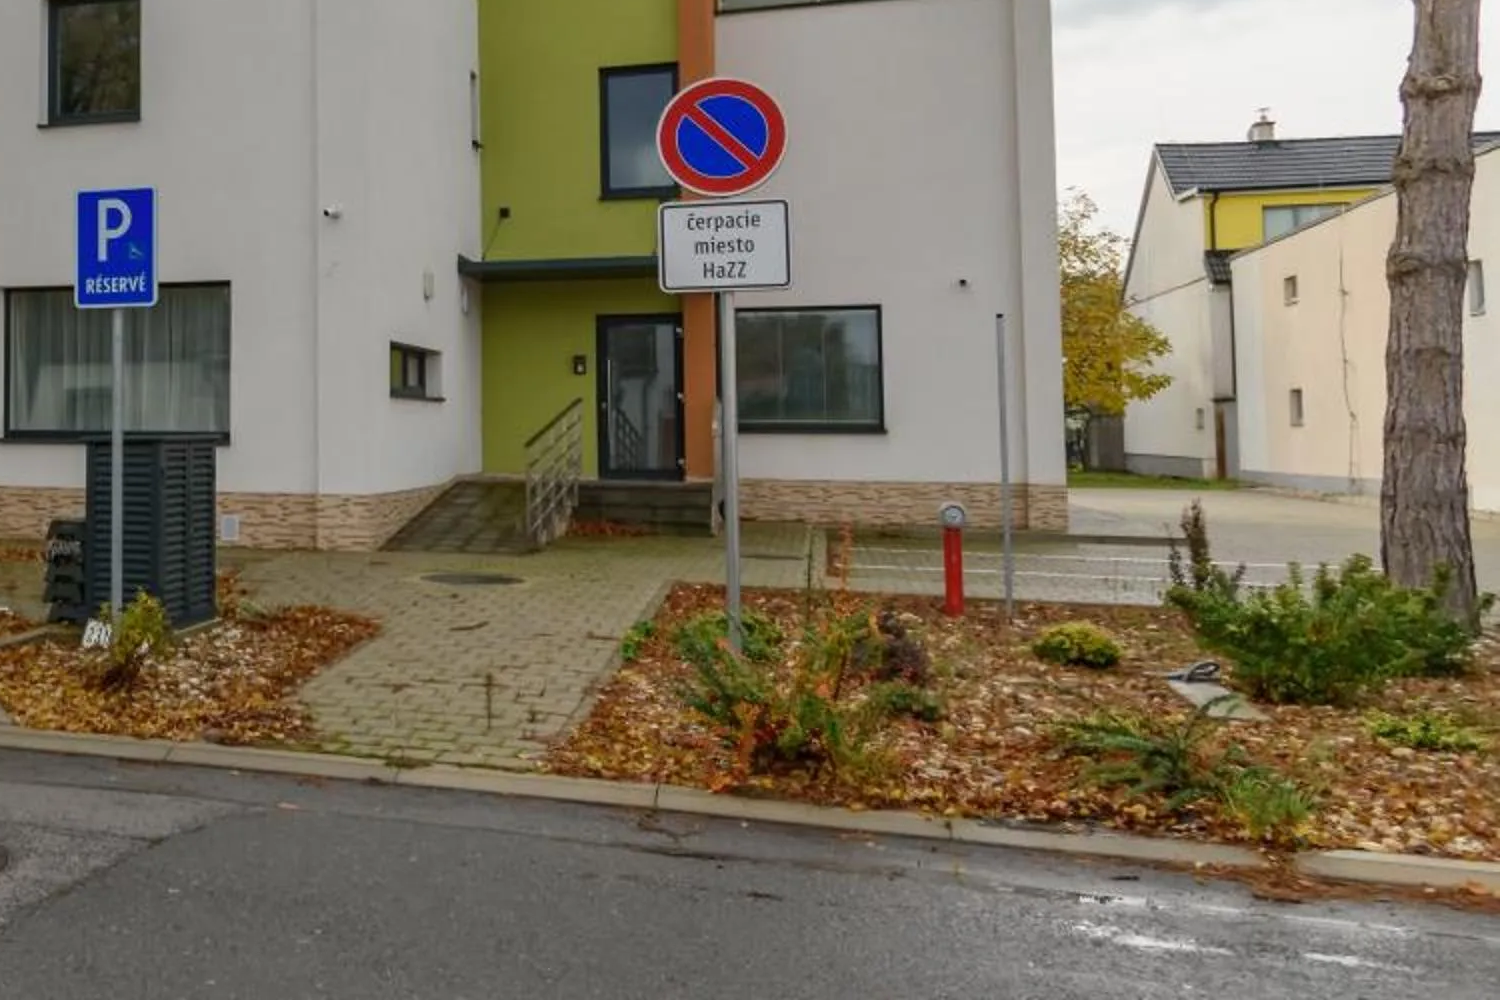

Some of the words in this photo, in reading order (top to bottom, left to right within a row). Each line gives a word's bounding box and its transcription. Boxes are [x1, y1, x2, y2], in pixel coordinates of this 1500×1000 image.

[97, 198, 133, 262] P
[694, 236, 755, 255] miesto
[703, 261, 747, 279] HaZZ
